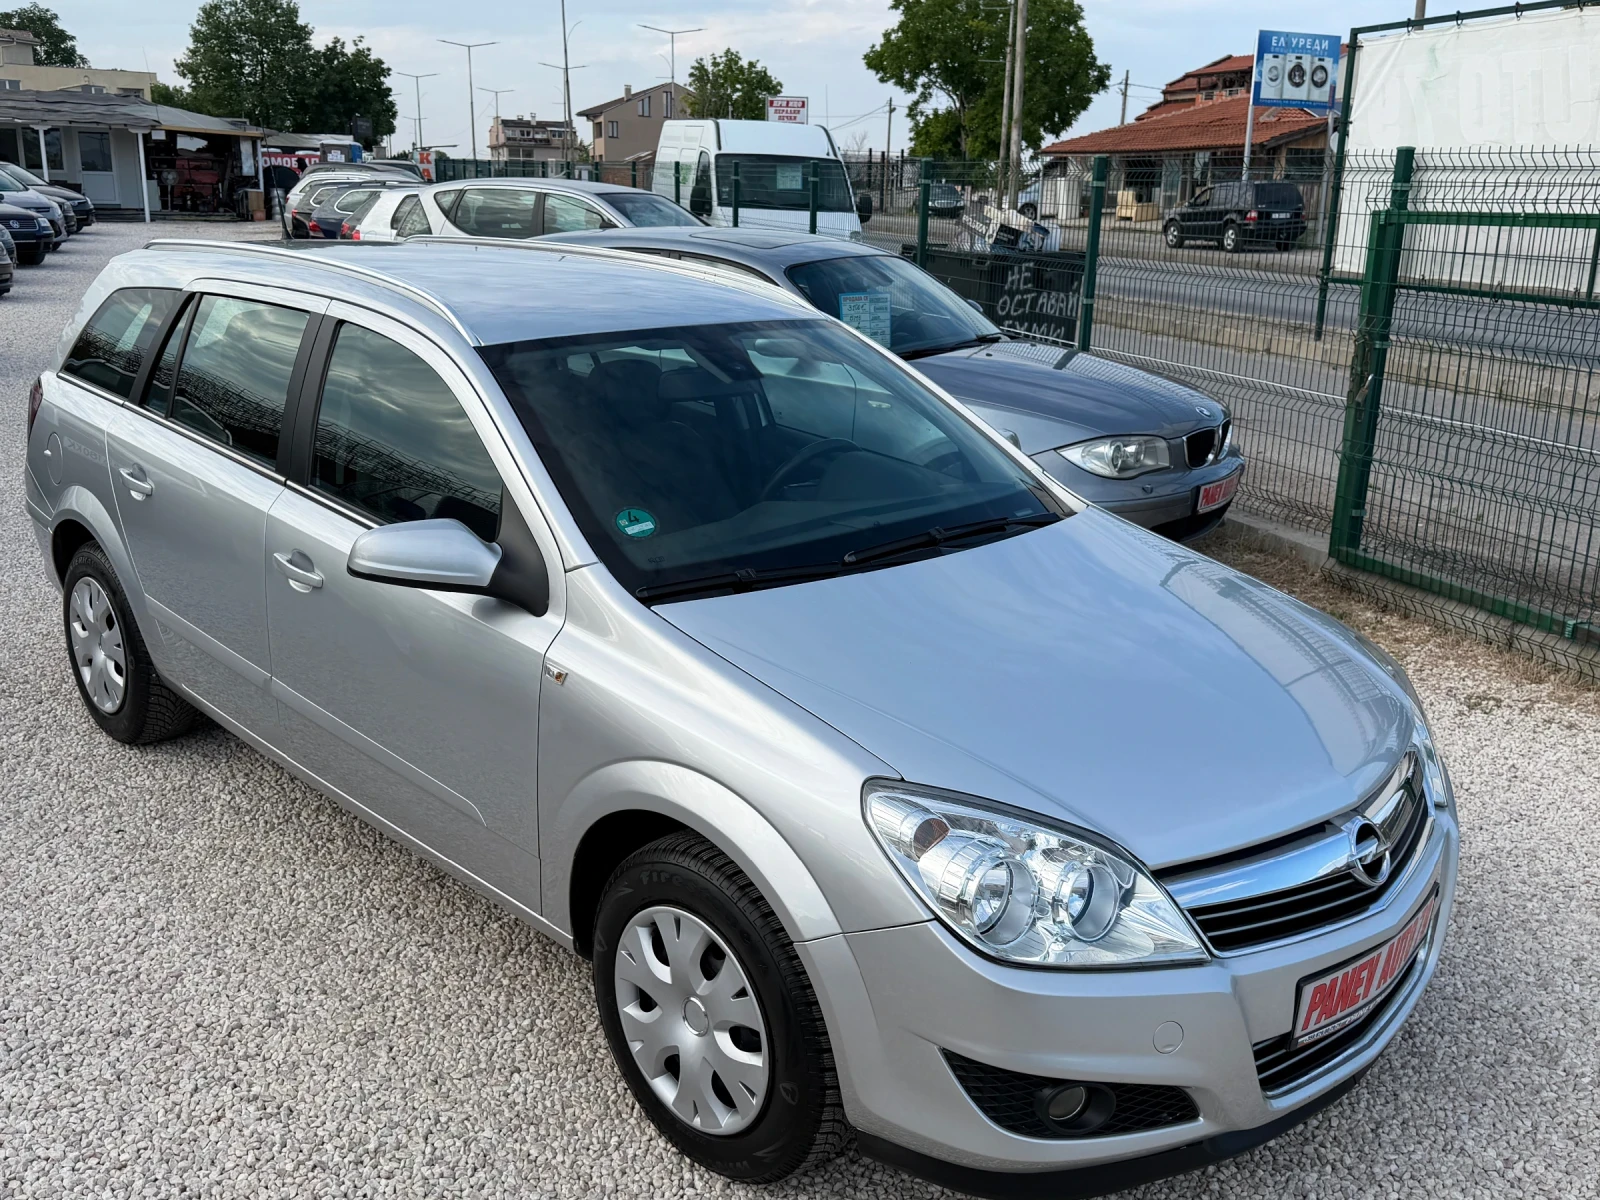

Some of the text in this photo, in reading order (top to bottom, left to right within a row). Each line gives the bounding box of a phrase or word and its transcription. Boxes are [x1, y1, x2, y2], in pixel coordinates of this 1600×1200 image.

[1271, 35, 1330, 51] ЕЛ УРЕДИ
[1005, 262, 1034, 290] НЕ
[627, 511, 640, 523] 4
[1301, 952, 1382, 1031] PANEV
